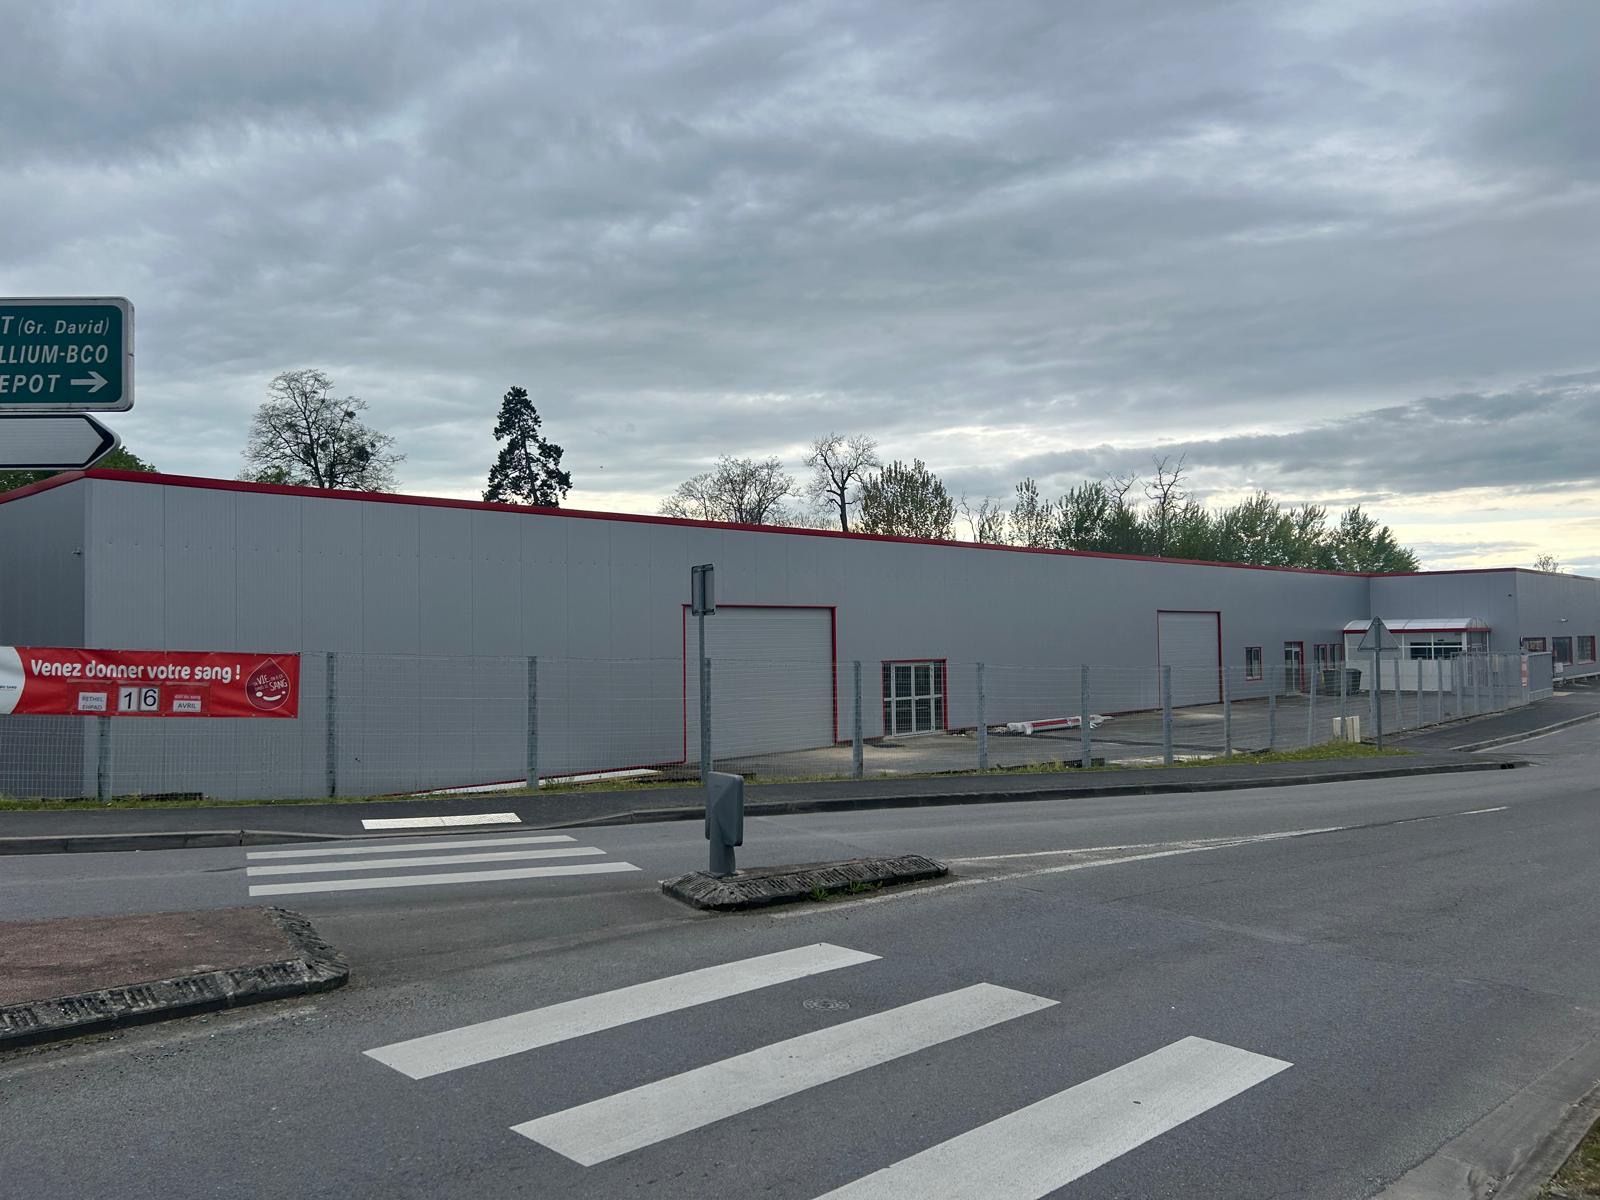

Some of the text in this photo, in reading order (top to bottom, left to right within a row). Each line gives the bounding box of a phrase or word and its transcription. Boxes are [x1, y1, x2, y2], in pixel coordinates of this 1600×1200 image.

[18, 317, 47, 336] (Gr.
[54, 317, 110, 336] David)
[31, 659, 241, 684] Venez donner votre sang !
